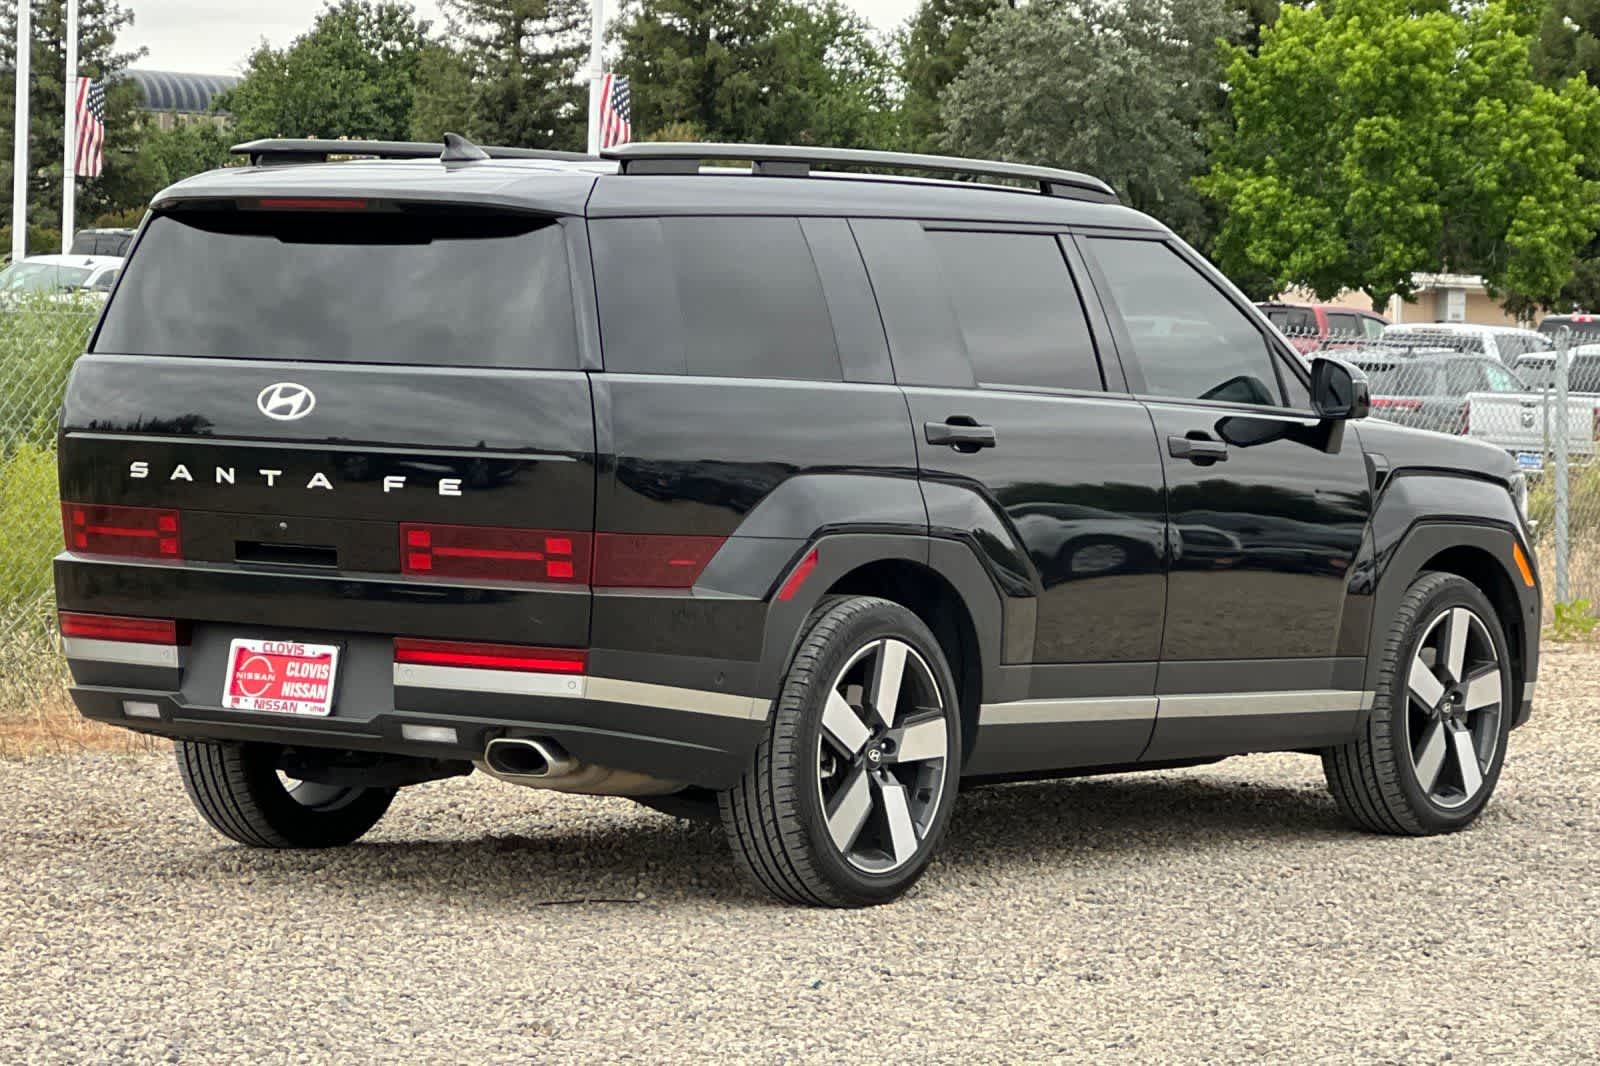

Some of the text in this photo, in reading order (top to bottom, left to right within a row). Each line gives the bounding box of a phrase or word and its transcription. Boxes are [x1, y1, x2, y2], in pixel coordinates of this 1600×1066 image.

[129, 461, 462, 496] SANTA FE
[262, 642, 305, 656] CLOVIS
[236, 671, 275, 681] NISSAN
[286, 661, 330, 679] CLOVIS
[281, 681, 327, 699] NISSAN
[253, 699, 298, 712] NISSAN
